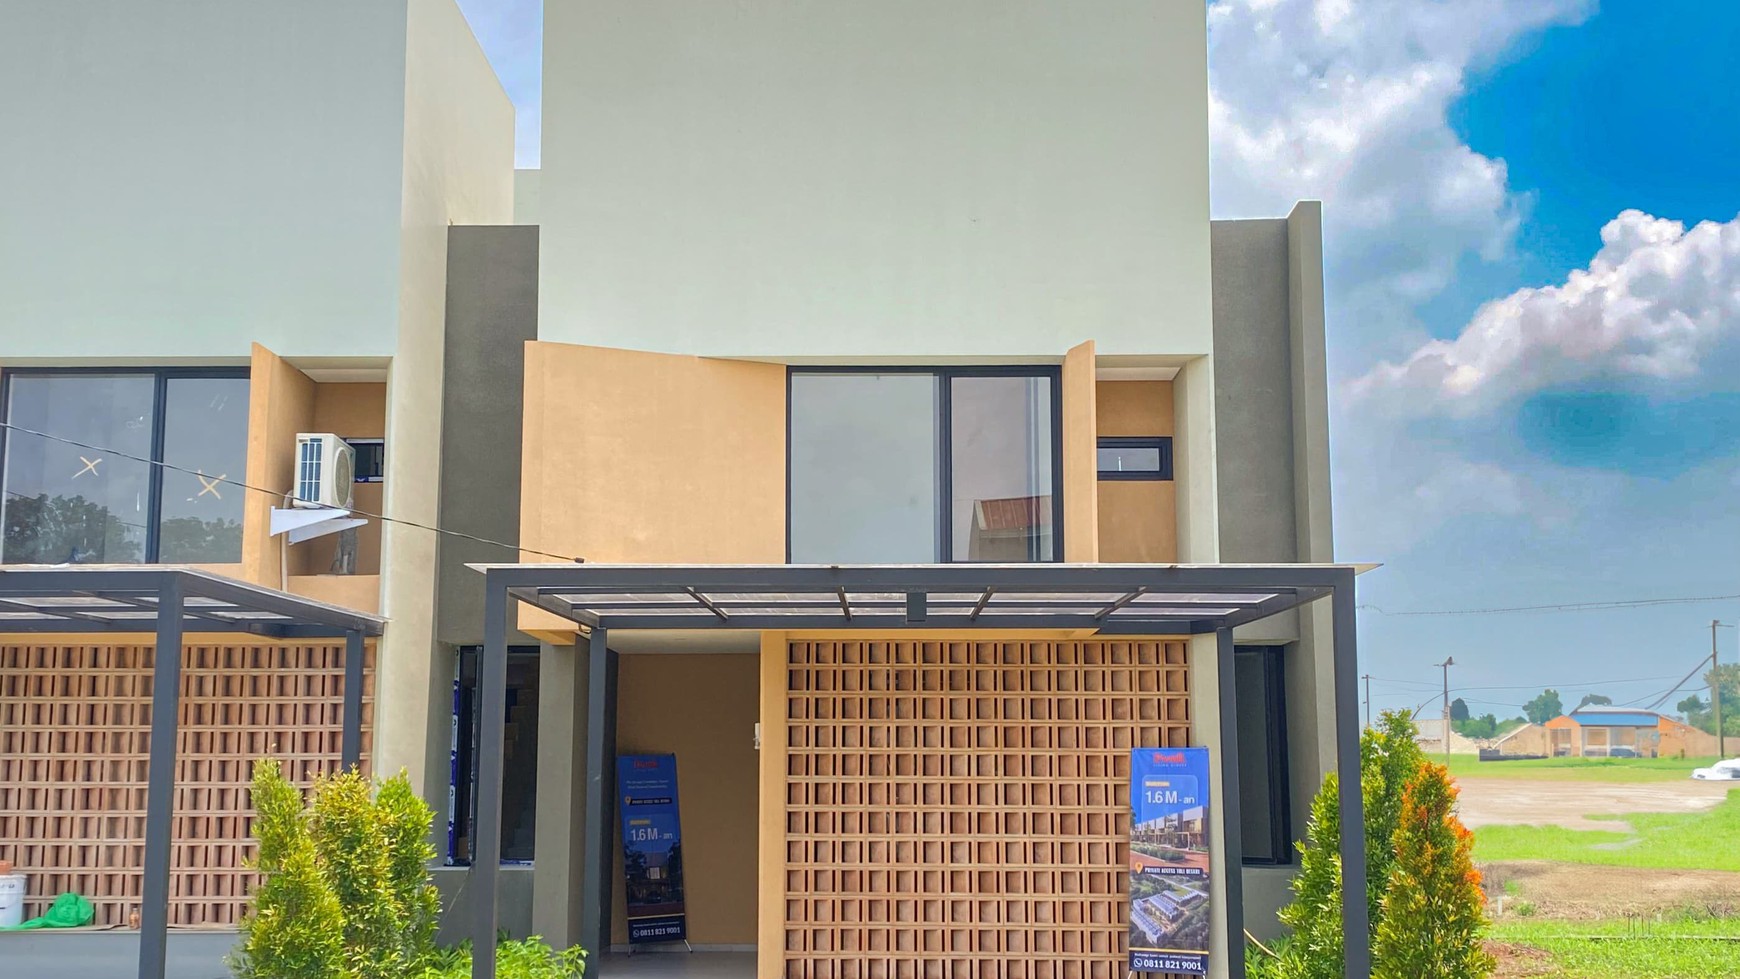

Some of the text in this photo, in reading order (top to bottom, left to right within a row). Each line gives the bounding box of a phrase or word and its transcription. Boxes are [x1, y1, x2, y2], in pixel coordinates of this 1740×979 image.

[1145, 790, 1164, 804] 1.6
[1165, 790, 1178, 804] M
[631, 828, 646, 841] 1.6
[647, 827, 658, 840] M
[1143, 959, 1202, 970] 0811 821 9001
